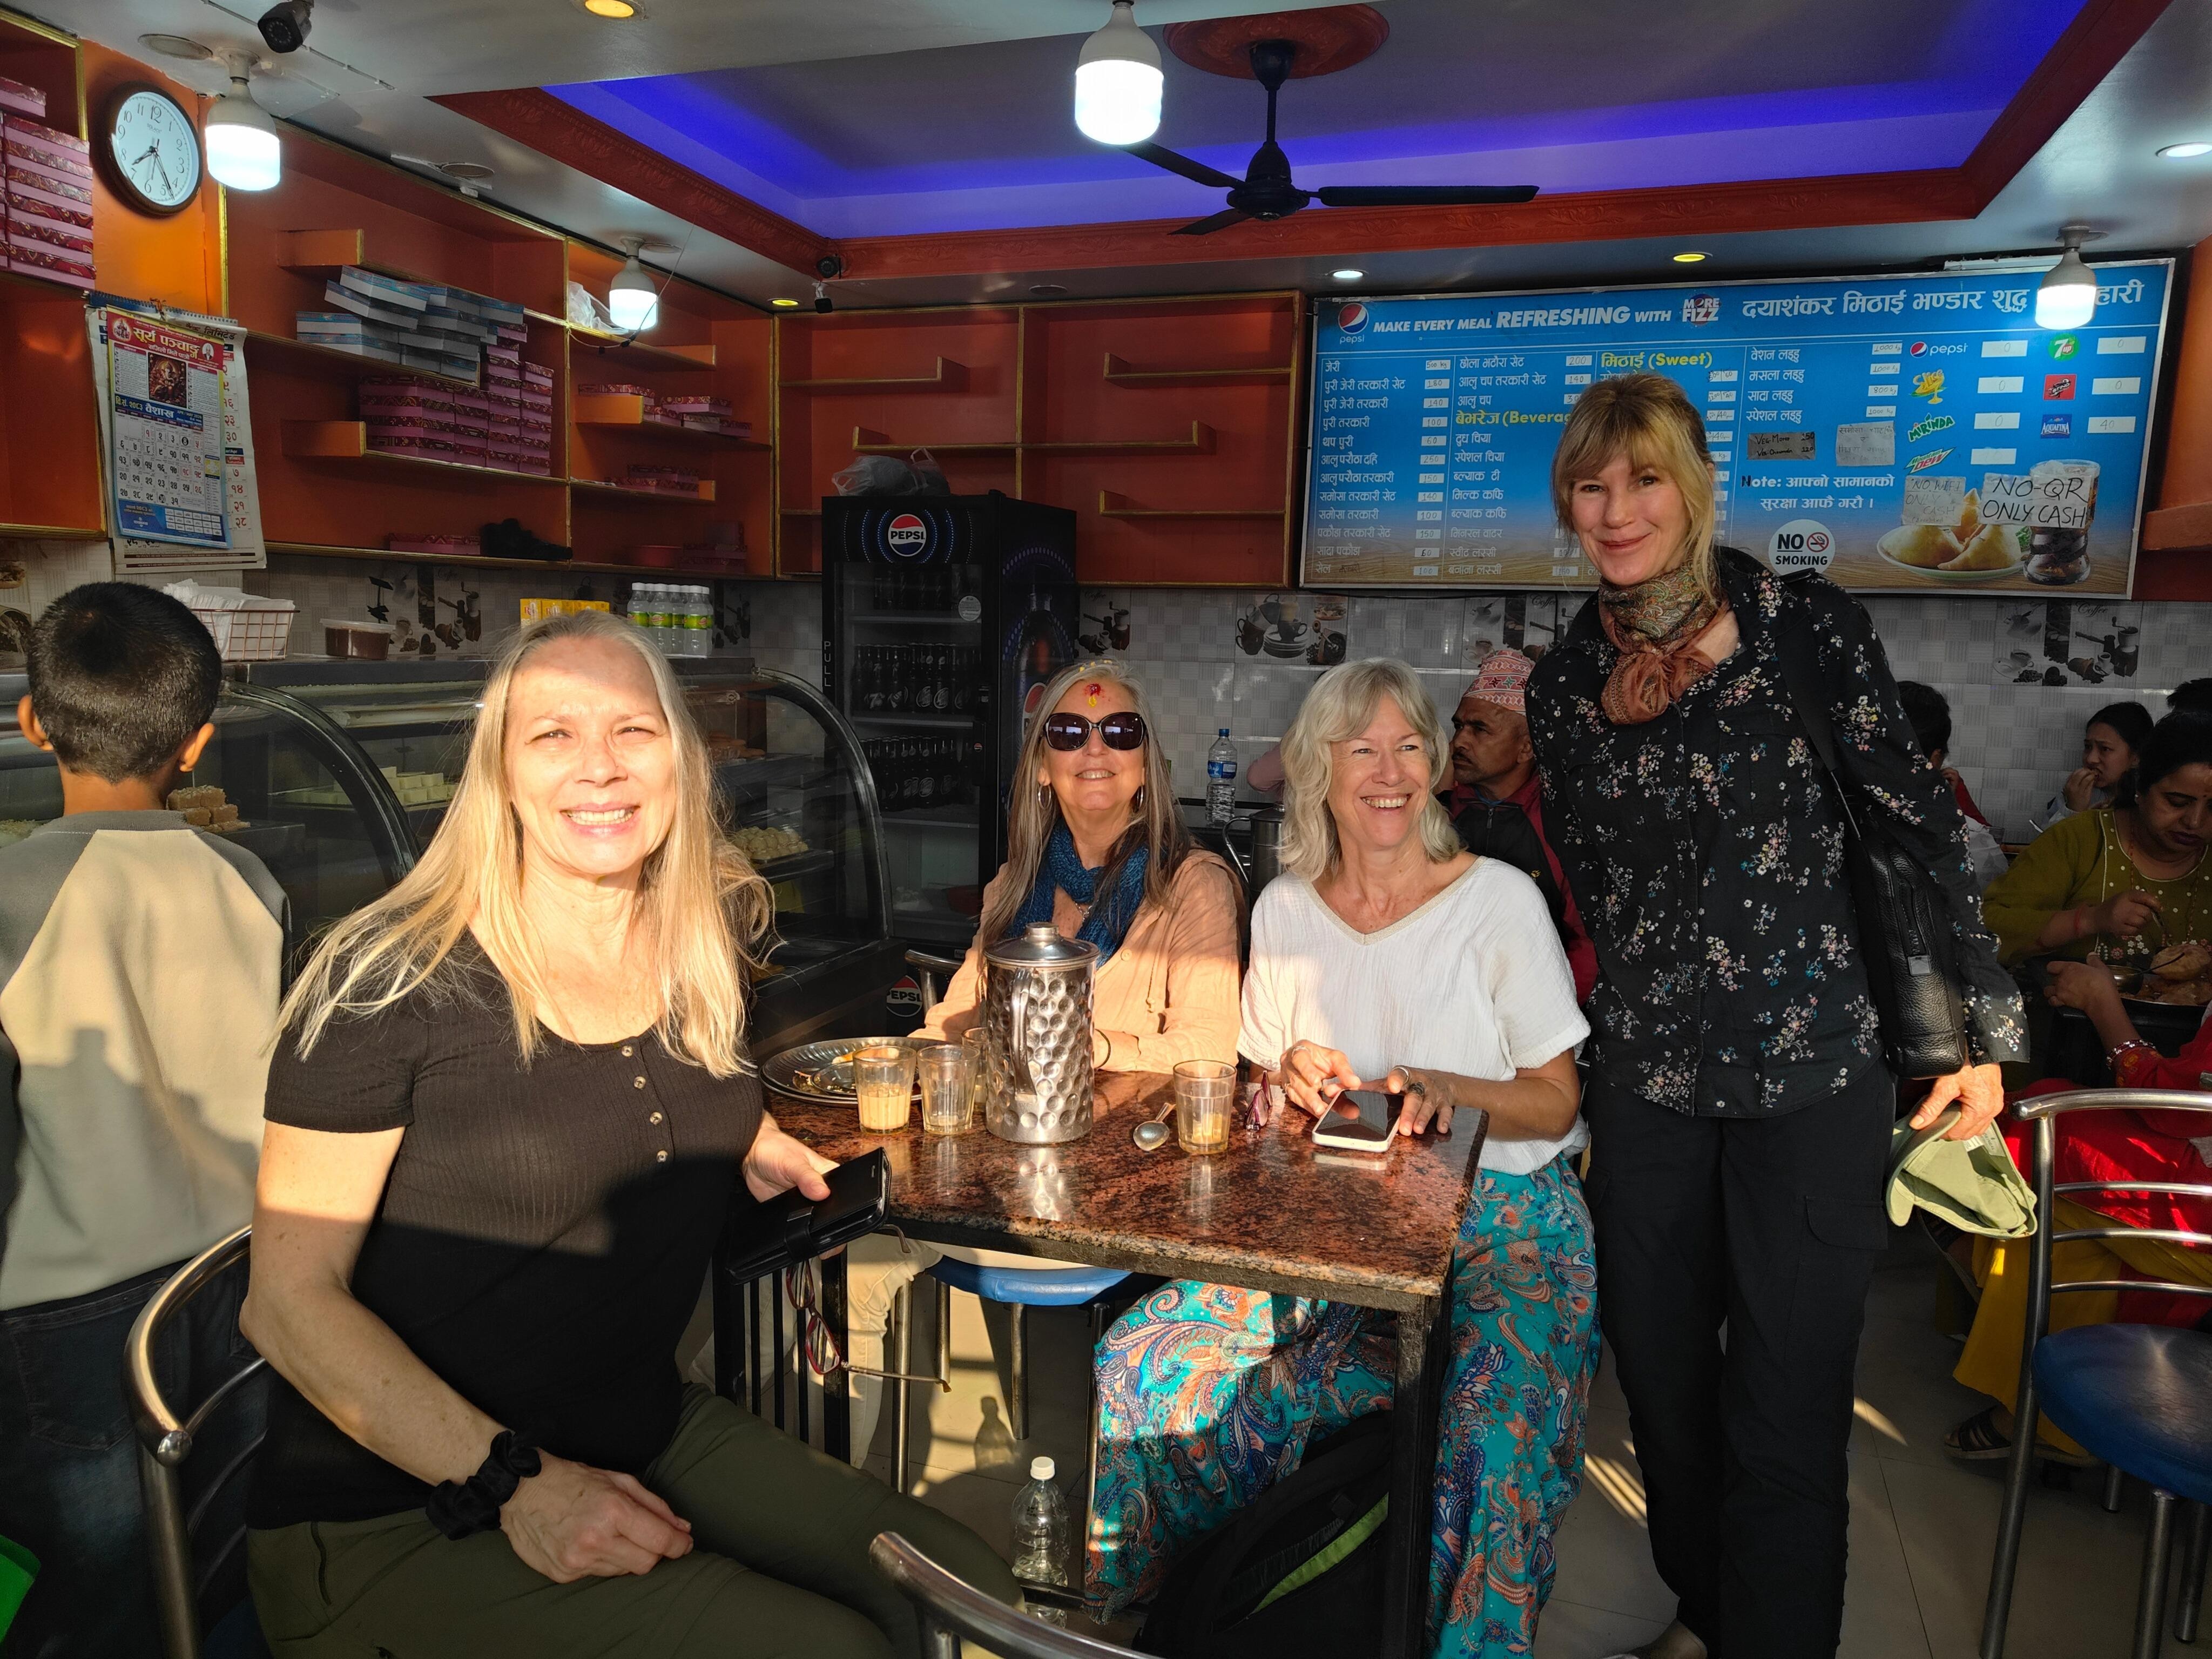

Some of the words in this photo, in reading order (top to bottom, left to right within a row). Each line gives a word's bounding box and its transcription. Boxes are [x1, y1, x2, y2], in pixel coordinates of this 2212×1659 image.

[138, 103, 144, 116] 11
[151, 105, 161, 123] 12
[124, 110, 132, 123] 10
[118, 125, 125, 140] 9
[169, 121, 172, 131] 1
[176, 139, 182, 151] 2
[121, 149, 126, 161] 8
[177, 158, 184, 173] 3
[131, 167, 137, 180] 7
[145, 179, 152, 193] 6
[172, 177, 178, 187] 4
[160, 184, 166, 196] 5
[1683, 298, 1719, 309] MORE
[1742, 295, 1837, 318] दयाशंकर
[1843, 289, 1906, 314] मिठाई
[1913, 291, 1986, 310] भण्डार
[1992, 288, 2030, 313] शुद्ध
[1373, 321, 1411, 332] MAKE
[1414, 319, 1455, 331] EVERY
[1457, 318, 1492, 330] MEAL
[1496, 306, 1631, 328] REFRESHING
[1635, 310, 1671, 322] WITH
[1682, 307, 1719, 322] FIZZ
[133, 327, 156, 343] सूर्य
[204, 326, 237, 340] लिमिटेड
[1340, 334, 1364, 344] pepsi
[1751, 347, 1775, 361] वेशन
[1930, 342, 1968, 356] pepsi
[1325, 360, 1340, 372] जेरी
[1460, 356, 1479, 369] छोला
[1482, 355, 1507, 368] भटौरा
[1510, 355, 1525, 367] सेट
[1569, 356, 1587, 365] 200
[1601, 352, 1645, 368] मिठाई
[1648, 351, 1712, 369] (Sweet)
[1459, 377, 1478, 390] आलु
[1480, 376, 1493, 386] चप
[1495, 373, 1529, 386] तरकारी
[1532, 372, 1547, 385] सेट
[1749, 370, 1780, 381] मसला
[1324, 379, 1338, 394] पुरी
[1340, 377, 1354, 390] जेरी
[1358, 377, 1390, 390] तरकारी
[1392, 376, 1406, 389] सेट
[1458, 395, 1477, 409] आलु
[1479, 395, 1492, 406] चप
[1748, 390, 1769, 402] सादा
[1324, 397, 1337, 412] पुरी
[1339, 396, 1354, 409] जेरी
[1357, 396, 1388, 409] तरकारी
[145, 403, 174, 419] वैशाख
[1455, 409, 1501, 425] बेभरेज
[1746, 407, 1777, 422] स्पेशल
[1323, 416, 1336, 430] पुरी
[1338, 415, 1370, 428] तरकारी
[1427, 419, 1441, 427] 100
[2040, 422, 2070, 434] AQUAFINA
[2100, 419, 2114, 430] 40
[226, 431, 237, 443] ३०
[1323, 436, 1336, 447] थप
[1339, 435, 1354, 449] पुरी
[1455, 433, 1469, 447] दुध
[1472, 431, 1491, 443] चिया
[170, 450, 177, 458] १०
[1321, 455, 1338, 467] आलु
[1340, 451, 1362, 464] परौठा
[1364, 453, 1378, 465] दहि
[1424, 455, 1439, 463] 250
[1454, 449, 1482, 463] स्पेशल
[1485, 450, 1505, 462] चिया
[119, 472, 127, 481] २०
[132, 475, 140, 483] २१
[1320, 473, 1337, 485] आलु
[1339, 469, 1361, 482] परौठा
[1363, 470, 1394, 483] तरकारी
[1423, 474, 1438, 482] 150
[1453, 471, 1485, 481] ब्ल्याक
[1491, 469, 1501, 481] टी
[1742, 475, 1782, 487] Note:
[1785, 474, 1829, 487] आफ्नो
[1833, 474, 1895, 487] सामानको
[158, 479, 165, 488] २३
[1993, 477, 2088, 503] NO-QR
[1319, 489, 1346, 502] समोसा
[1348, 490, 1380, 502] तरकारी
[1382, 488, 1397, 501] सेट
[1421, 493, 1437, 501] 140
[1452, 488, 1480, 500] मिल्क
[1482, 488, 1503, 500] कफि
[171, 497, 178, 505] ३१
[234, 501, 245, 512] २१
[1761, 497, 1798, 511] सुरक्षा
[1801, 495, 1835, 509] आफै
[1838, 495, 1864, 509] गरौ
[1318, 507, 1345, 520] समोसा
[1347, 508, 1379, 520] तरकारी
[1421, 511, 1437, 520] 100
[1451, 508, 1483, 518] ब्ल्याक
[1486, 507, 1507, 518] कफि
[1982, 500, 2035, 522] ONLY
[2038, 505, 2087, 528] CASH
[235, 517, 247, 528] २८
[891, 531, 923, 540] PEPSI
[1317, 524, 1341, 537] पकौडा
[1344, 527, 1375, 538] तरकारी
[1377, 525, 1391, 538] सेट
[1420, 530, 1434, 538] 150
[1451, 527, 1480, 538] मिनरल
[1483, 529, 1503, 538] वाटर
[1777, 534, 1804, 550] NO
[1317, 546, 1334, 556] सादा
[1337, 542, 1361, 556] पकौडा
[1449, 546, 1470, 557] स्वीट
[1473, 547, 1496, 557] लस्सी
[1775, 555, 1828, 565] SMOKING
[1314, 562, 1331, 574] सेल
[1419, 567, 1434, 575] 100
[1448, 564, 1474, 575] बनाना
[1476, 563, 1502, 575] लस्सी
[2075, 601, 2108, 617] Coffee
